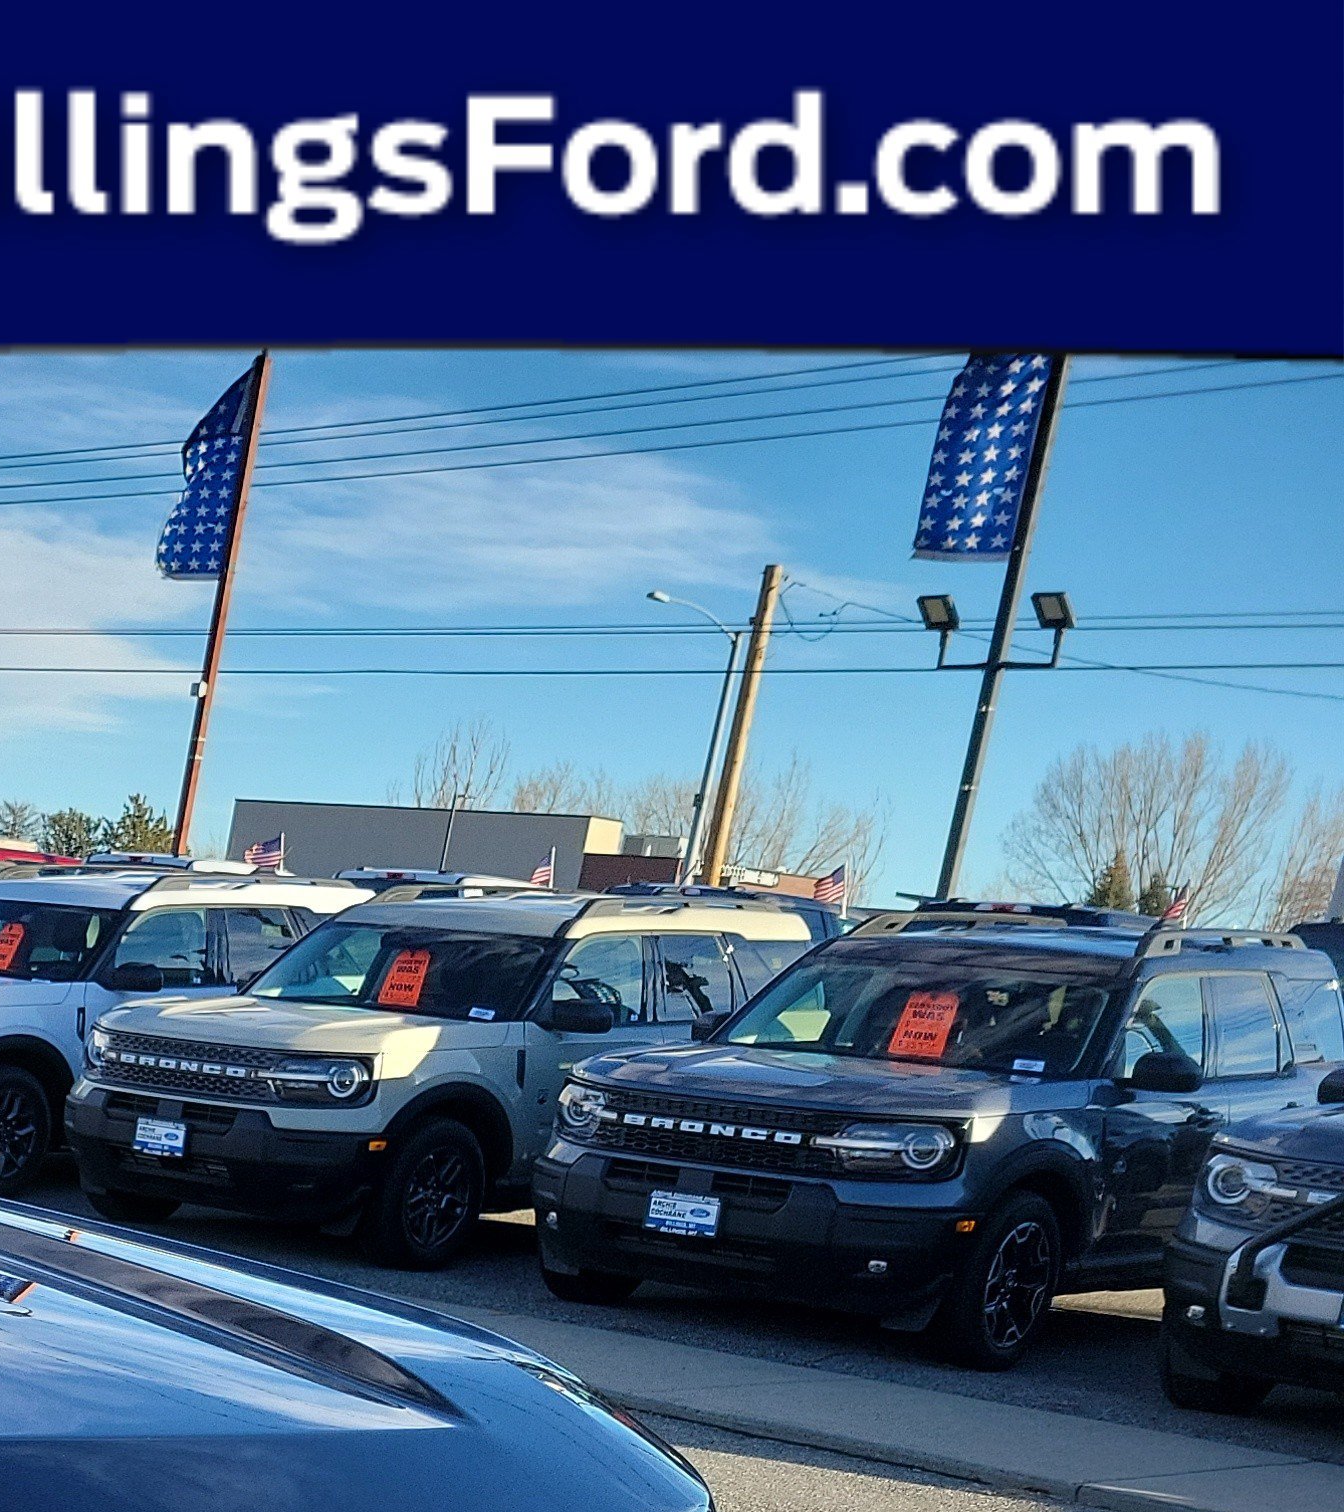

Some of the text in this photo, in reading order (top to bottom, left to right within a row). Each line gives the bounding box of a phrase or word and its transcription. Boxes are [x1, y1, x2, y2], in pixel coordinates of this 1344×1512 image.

[396, 965, 420, 974] WAS
[388, 983, 415, 992] NOW
[912, 1010, 944, 1021] WAS
[903, 1030, 938, 1041] NOW
[120, 1053, 246, 1078] BRONCO
[623, 1113, 802, 1145] BRONCO
[651, 1208, 686, 1219] COCHRANE
